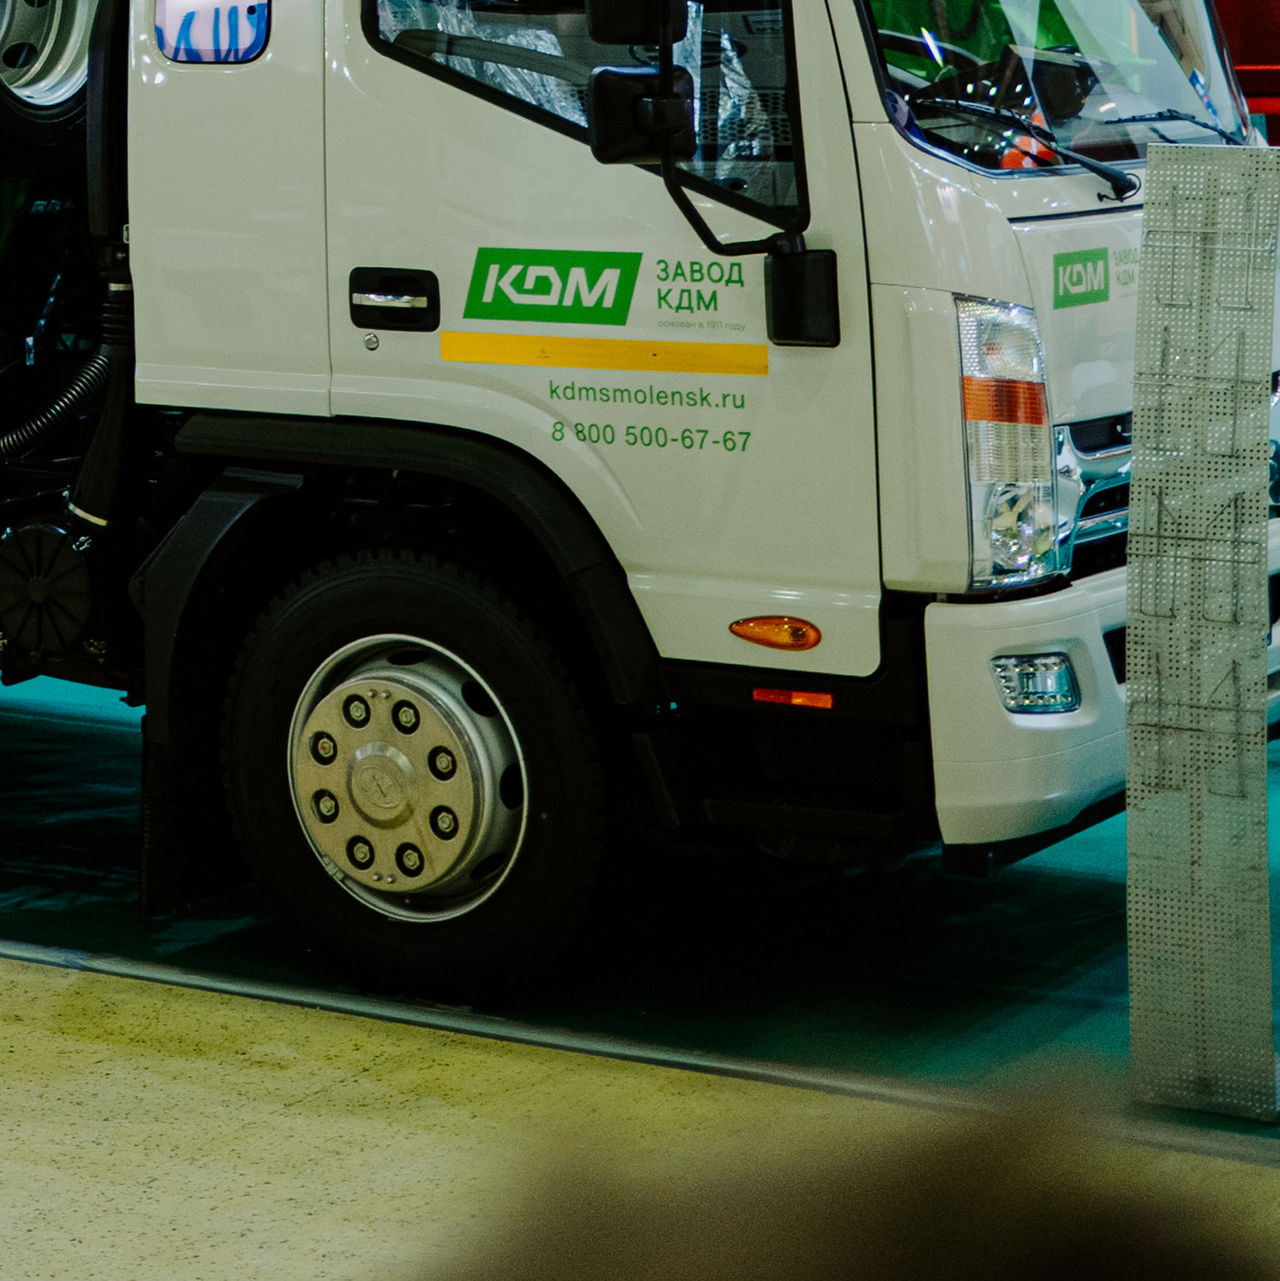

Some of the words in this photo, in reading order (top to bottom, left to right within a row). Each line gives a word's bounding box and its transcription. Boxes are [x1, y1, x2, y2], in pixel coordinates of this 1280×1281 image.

[656, 259, 744, 287] ЗАВОД
[657, 288, 718, 314] КДМ
[549, 380, 745, 409] kdmsmolensk.ru
[551, 421, 565, 442] 8
[574, 423, 616, 446] 800
[625, 426, 751, 452] 500-67-67
